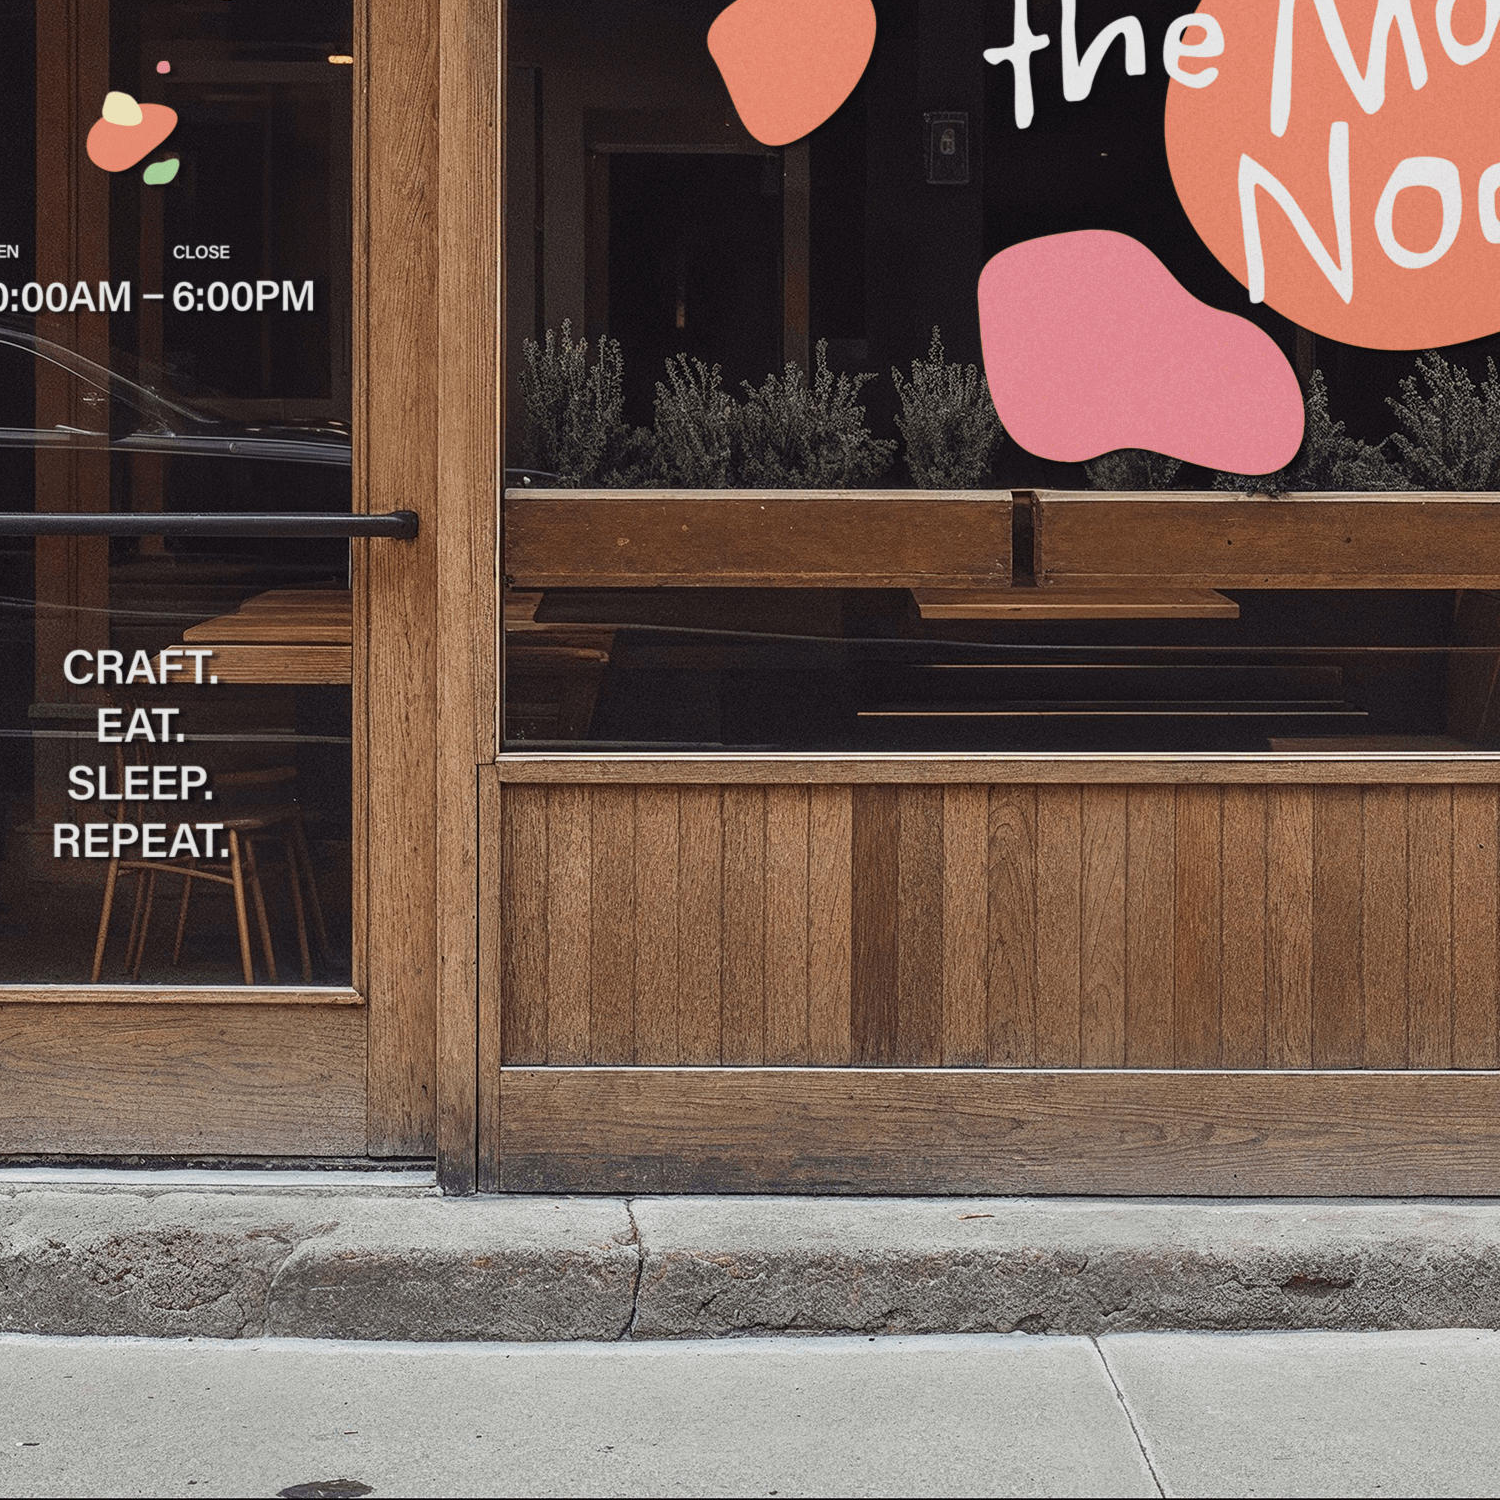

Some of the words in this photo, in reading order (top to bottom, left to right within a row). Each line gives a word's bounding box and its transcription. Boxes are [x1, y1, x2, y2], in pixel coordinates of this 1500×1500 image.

[172, 244, 230, 260] CLOSE
[172, 280, 315, 312] 6:00PM
[63, 649, 218, 685] CRAFT.
[98, 707, 185, 743] EAT.
[67, 765, 213, 801] SLEEP.
[53, 823, 229, 858] REPEAT.
